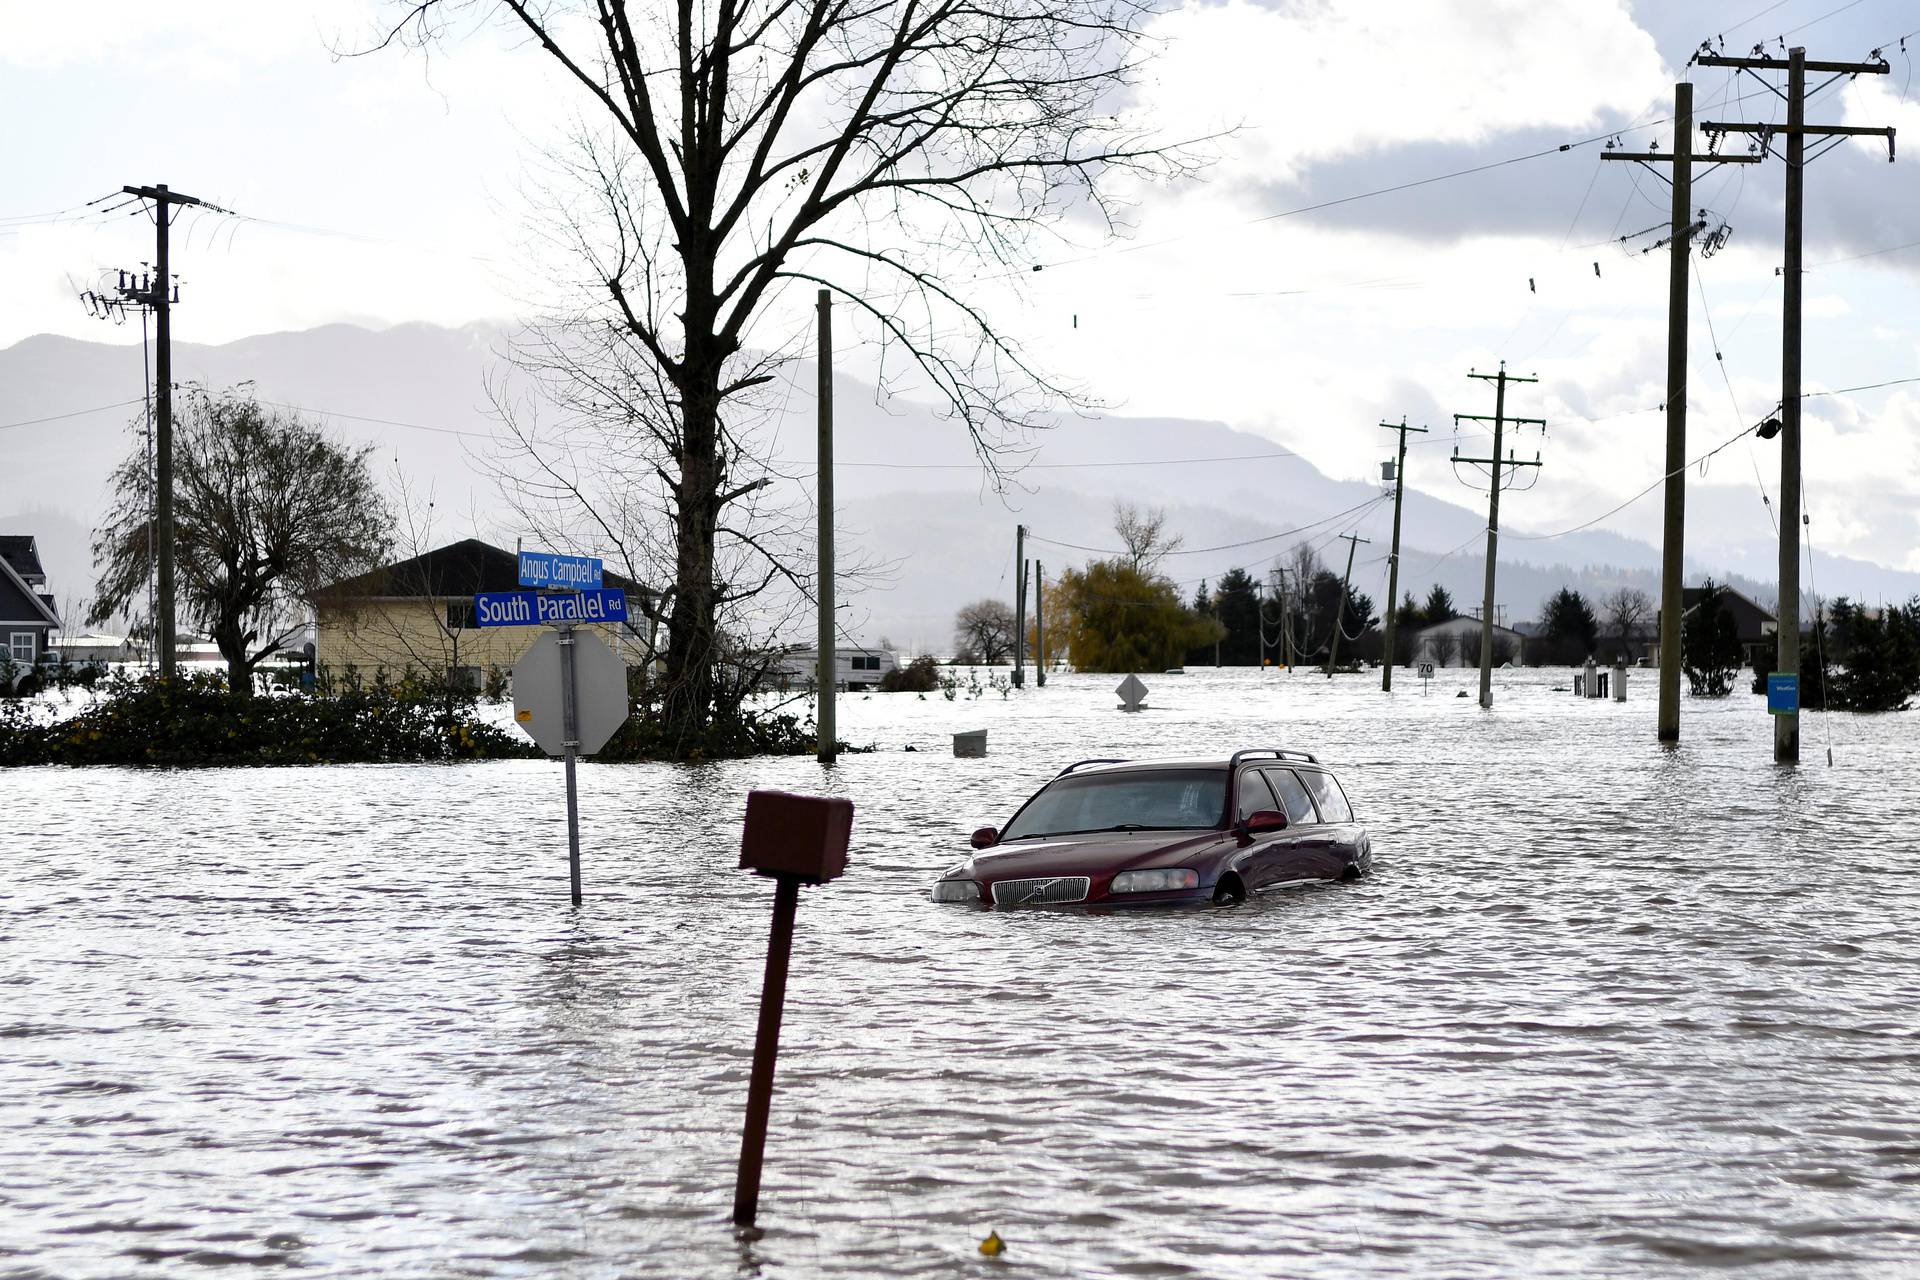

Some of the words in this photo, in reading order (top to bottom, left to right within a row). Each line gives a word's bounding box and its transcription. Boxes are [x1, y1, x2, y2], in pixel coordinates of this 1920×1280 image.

[521, 556, 548, 584] Angus
[552, 559, 592, 585] Campbell
[593, 569, 601, 580] Rd
[479, 595, 530, 622] South
[536, 592, 605, 620] Parallel
[608, 598, 621, 610] Rd
[1420, 664, 1432, 673] 70
